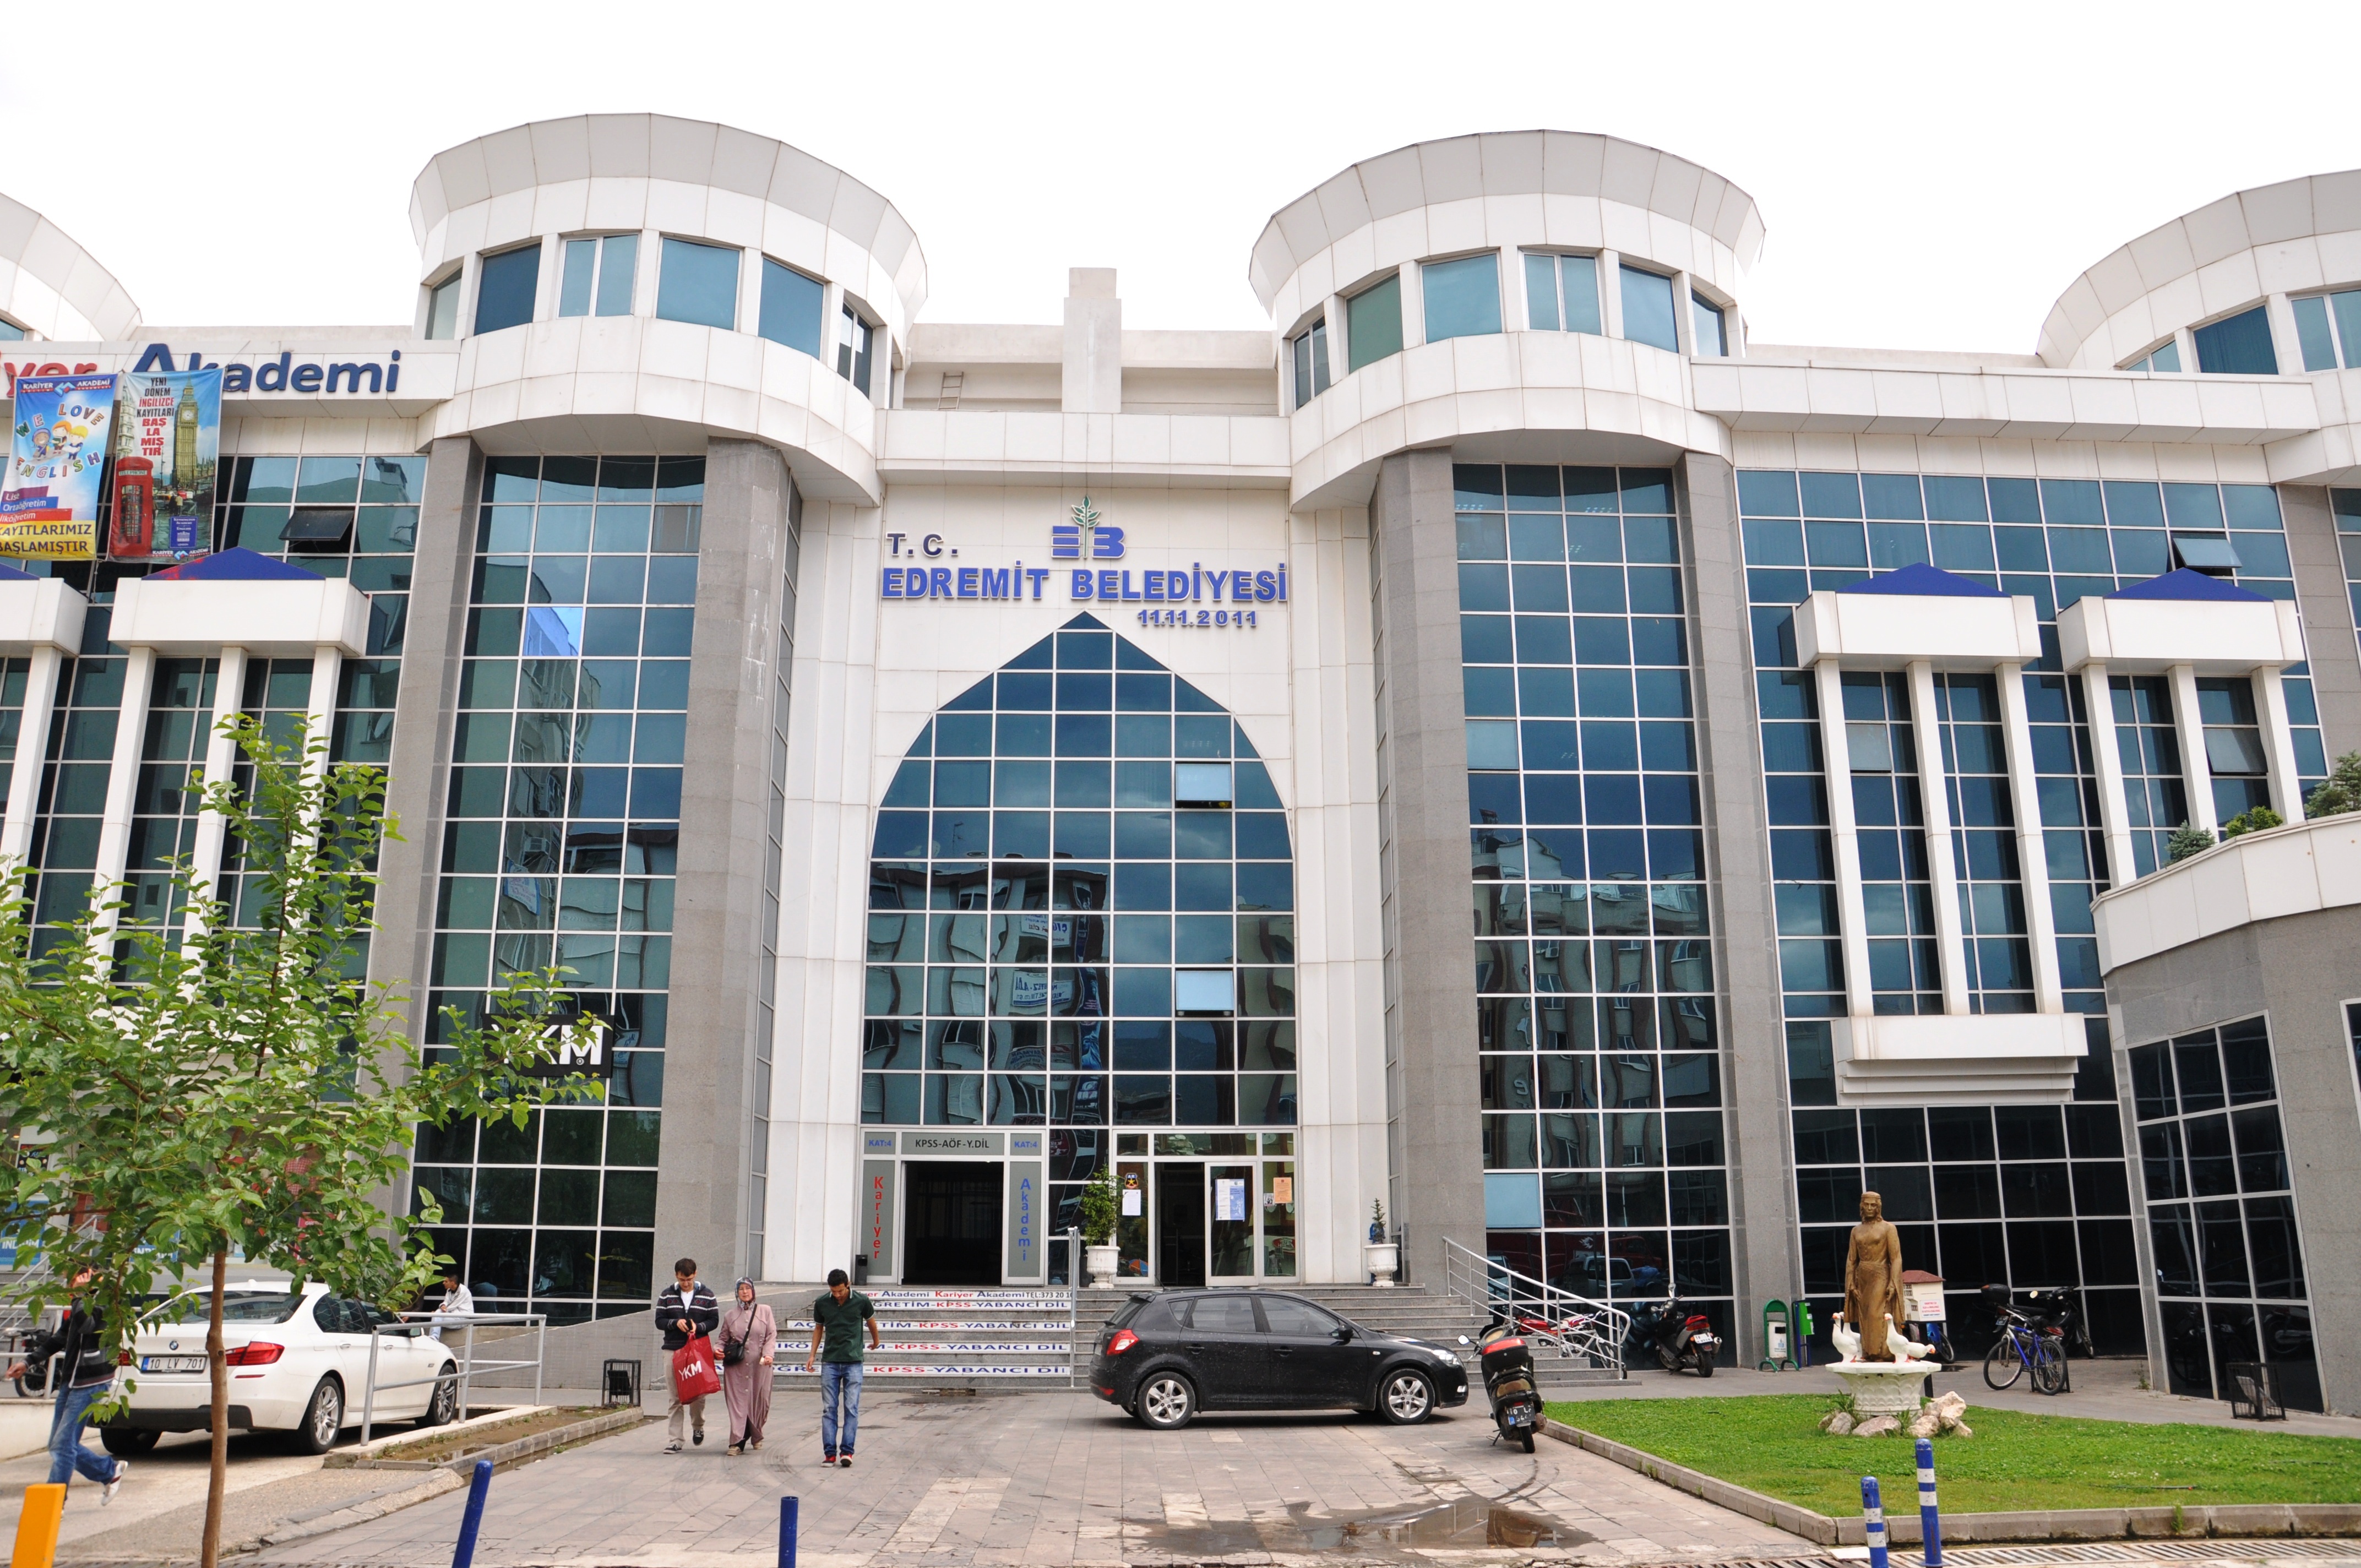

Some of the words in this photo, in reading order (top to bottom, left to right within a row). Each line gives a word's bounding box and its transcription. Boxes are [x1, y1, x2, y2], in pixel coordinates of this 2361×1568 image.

[77, 378, 110, 387] AKADEMİ
[145, 386, 171, 396] DÖNEM
[139, 396, 175, 407] İNGİLİZCE
[137, 408, 175, 418] KAYITLARI
[16, 414, 44, 438] WE
[58, 404, 105, 426] LOVE
[142, 417, 167, 428] BAŞ
[146, 428, 160, 436] LA
[140, 437, 164, 448] MIŞ
[142, 447, 161, 456] TIR
[16, 451, 101, 478] ENGLISH
[6, 493, 20, 501] Lise
[3, 499, 47, 512] Ortaöğretim
[881, 559, 1049, 600] EDREMİT
[1071, 561, 1288, 602] BELEDİYESİ
[1137, 609, 1258, 628] 11.11.2011
[868, 1139, 892, 1147] KAT:4
[873, 1176, 884, 1259] Kariyer
[1018, 1178, 1031, 1261] Akademi
[150, 1359, 161, 1369] 10
[167, 1358, 180, 1369] LV
[186, 1358, 203, 1369] 701
[678, 1360, 703, 1381] YKM
